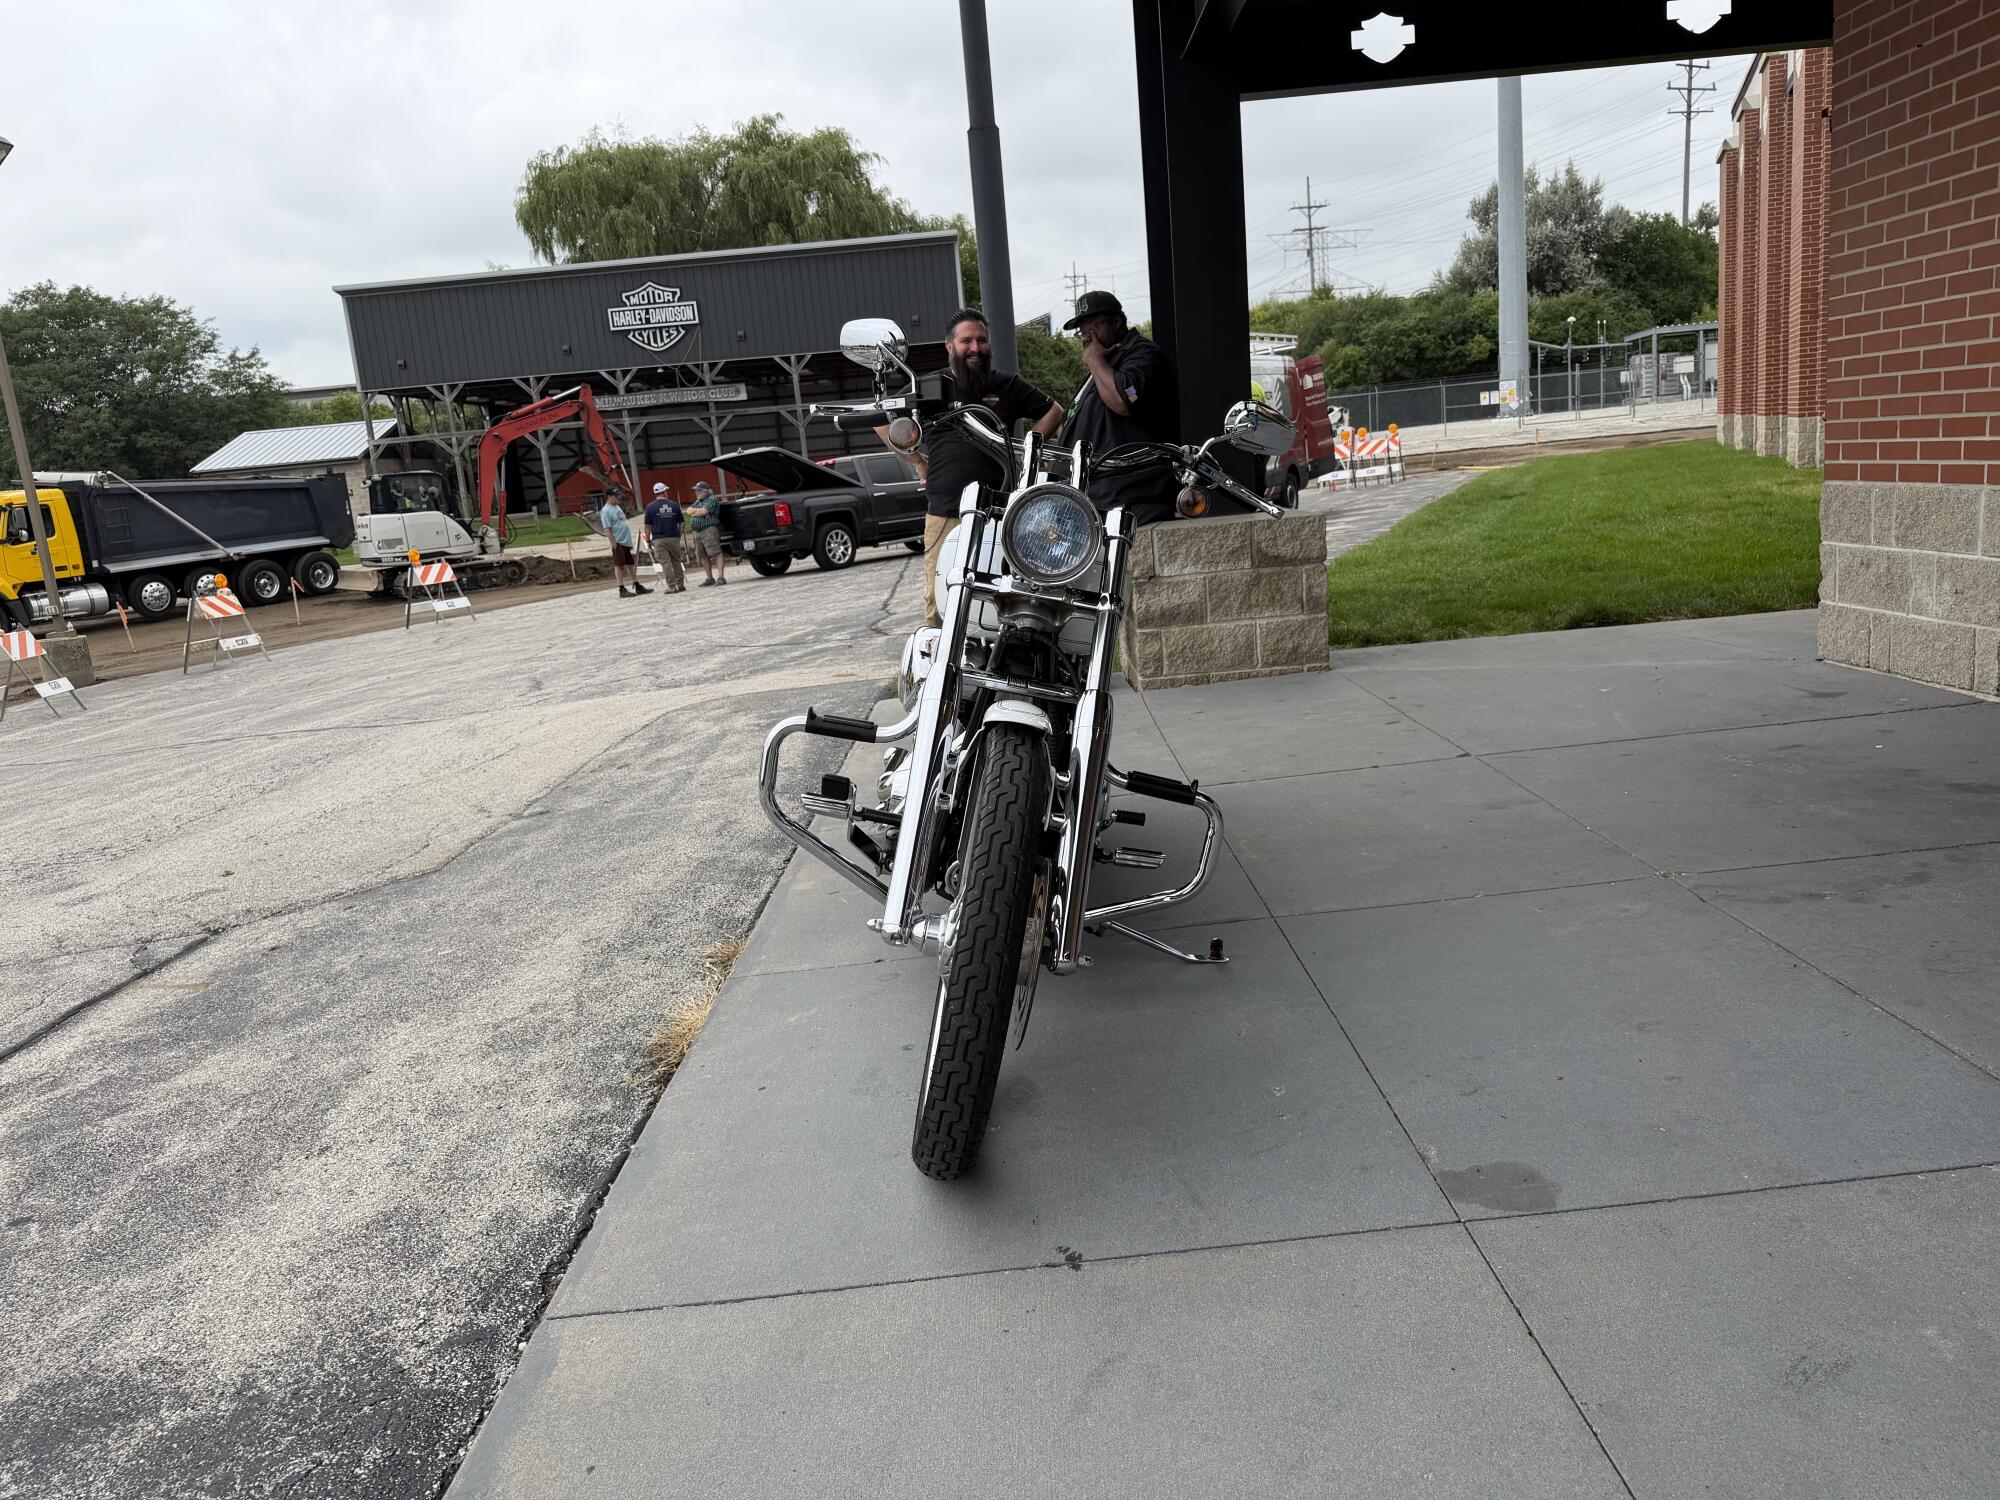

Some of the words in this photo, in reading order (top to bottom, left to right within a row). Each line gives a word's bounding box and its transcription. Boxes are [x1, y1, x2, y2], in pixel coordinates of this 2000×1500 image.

[629, 286, 674, 306] MOTOR
[612, 305, 694, 327] HARLEY-DAVIDSON
[634, 326, 678, 347] CYCLES
[594, 394, 657, 409] MILWAUKEE
